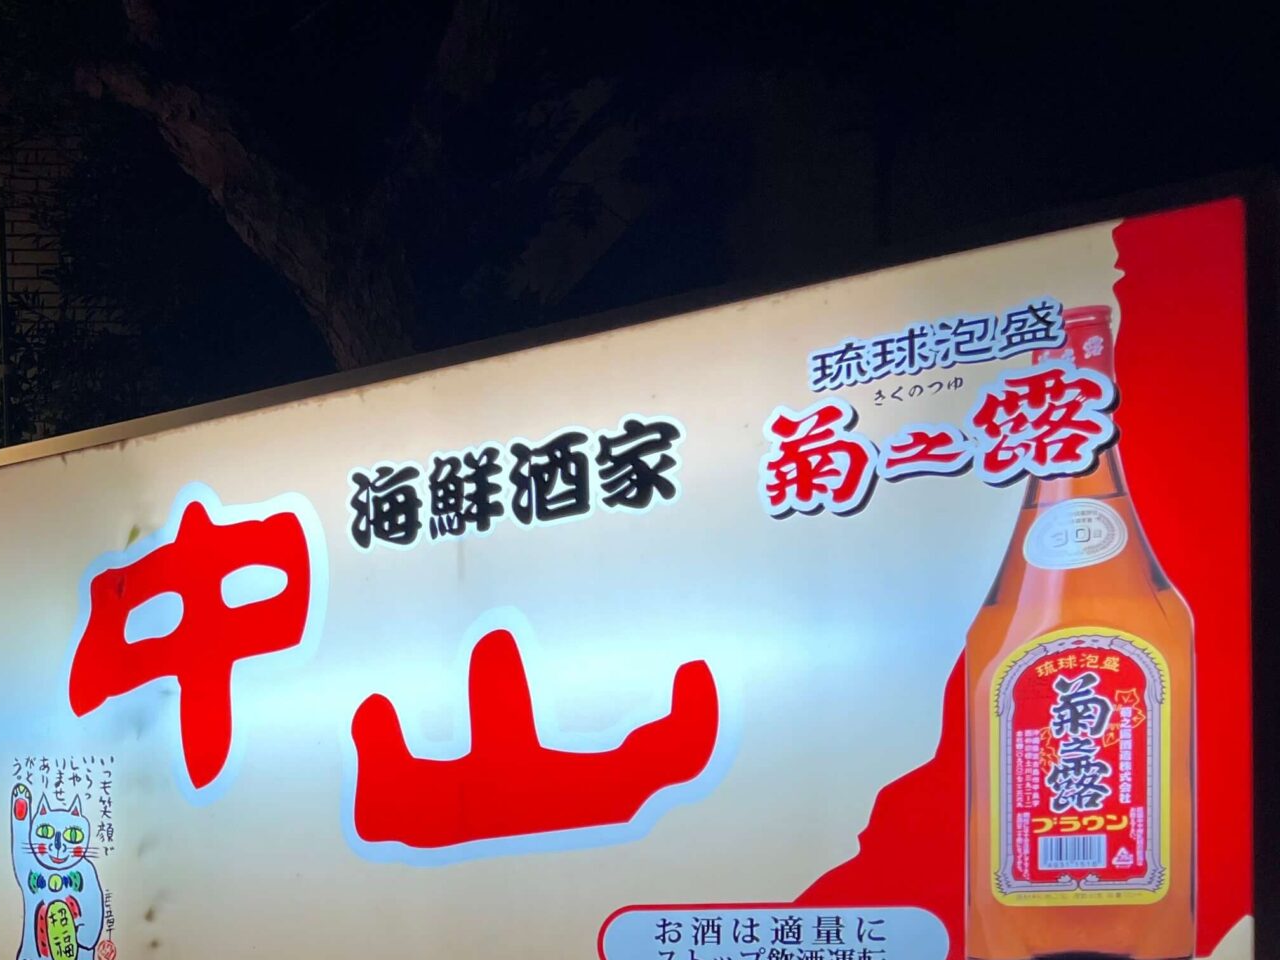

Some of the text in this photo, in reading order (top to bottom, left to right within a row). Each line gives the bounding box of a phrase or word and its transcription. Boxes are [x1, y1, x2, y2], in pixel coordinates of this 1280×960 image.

[811, 301, 1063, 388] 琉球泡盛
[874, 376, 964, 406] きくのつゆ
[766, 368, 1104, 508] 菊之露
[351, 420, 683, 549] 海鮮酒家
[68, 500, 720, 849] 中山
[1035, 652, 1120, 678] 琉球泡盛
[1047, 672, 1113, 813] 菊之露
[96, 756, 115, 856] いつも笑顔で
[1031, 815, 1129, 834] ブラウン
[48, 908, 77, 958] 招福
[654, 915, 887, 946] お酒は適量に
